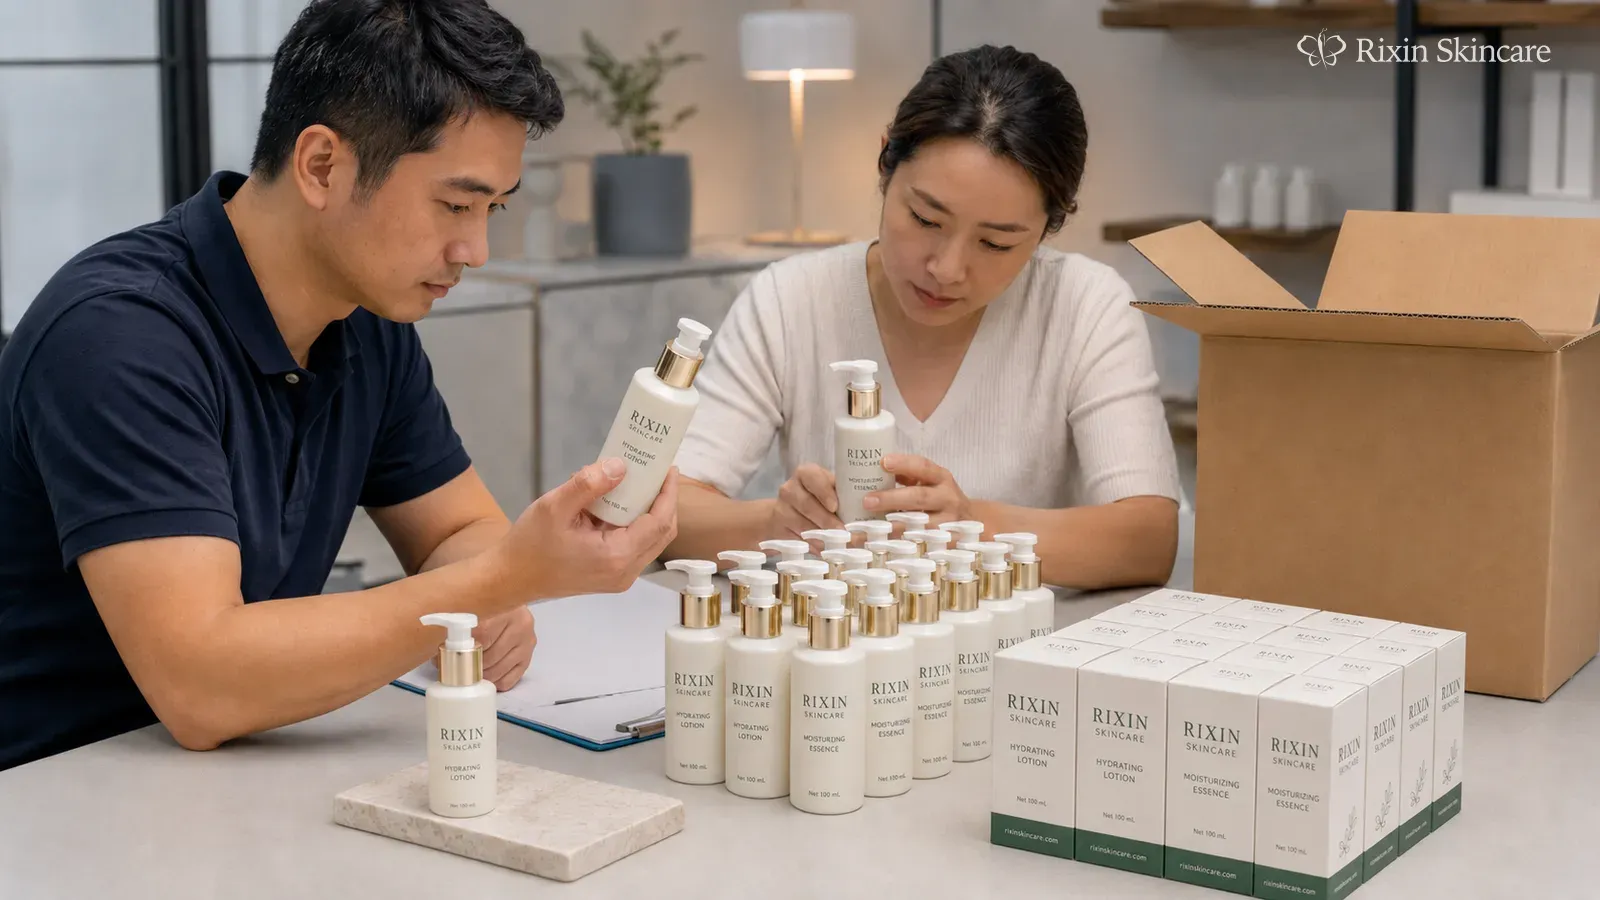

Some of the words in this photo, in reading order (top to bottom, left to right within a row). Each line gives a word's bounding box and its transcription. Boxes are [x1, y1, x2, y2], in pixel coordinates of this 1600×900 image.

[631, 410, 671, 435] RIXIN
[622, 441, 656, 460] HYDRATING
[848, 448, 882, 459] RIXIN
[624, 452, 647, 466] LOTION
[958, 651, 990, 665] RIXIN
[919, 663, 951, 678] RIXIN
[675, 672, 714, 686] RIXIN
[920, 679, 949, 688] SKINCARE
[733, 682, 772, 698] RIXIN
[871, 679, 909, 694] RIXIN
[1441, 678, 1460, 700] RIXIN
[733, 699, 770, 708] SKINCARE
[803, 694, 847, 708] RIXIN
[873, 696, 907, 704] SKINCARE
[1008, 694, 1059, 716] RIXIN
[1408, 695, 1429, 719] RIXIN
[805, 711, 844, 719] SKINCARE
[1010, 714, 1056, 729] SKINCARE
[1093, 707, 1148, 730] RIXIN
[734, 722, 769, 731] HYDRATING
[879, 729, 905, 737] ESSENCE
[1184, 721, 1240, 744] RIXIN
[1373, 714, 1396, 741] RIXIN
[441, 727, 483, 741] RIXIN
[1095, 728, 1144, 743] SKINCARE
[1010, 744, 1055, 757] HYDRATING
[1186, 743, 1236, 757] SKINCARE
[1271, 737, 1319, 758] RIXIN
[1338, 736, 1360, 763] RIXIN
[1017, 756, 1047, 767] LOTION
[1096, 759, 1143, 772] HYDRATING
[1273, 757, 1316, 771] SKINCARE
[1104, 771, 1135, 783] LOTION
[1184, 773, 1240, 789] MOISTURIZING
[1193, 786, 1229, 799] ESSENCE
[1268, 787, 1320, 802] MOISTURIZING
[1277, 800, 1309, 812] ESSENCE
[1005, 828, 1058, 844] rixinskincare.com
[1205, 830, 1216, 838] 100
[1090, 845, 1147, 861] rixinskincare.com
[1180, 863, 1236, 879] rixinskincare.com
[1263, 880, 1316, 895] rixinskincare.com
